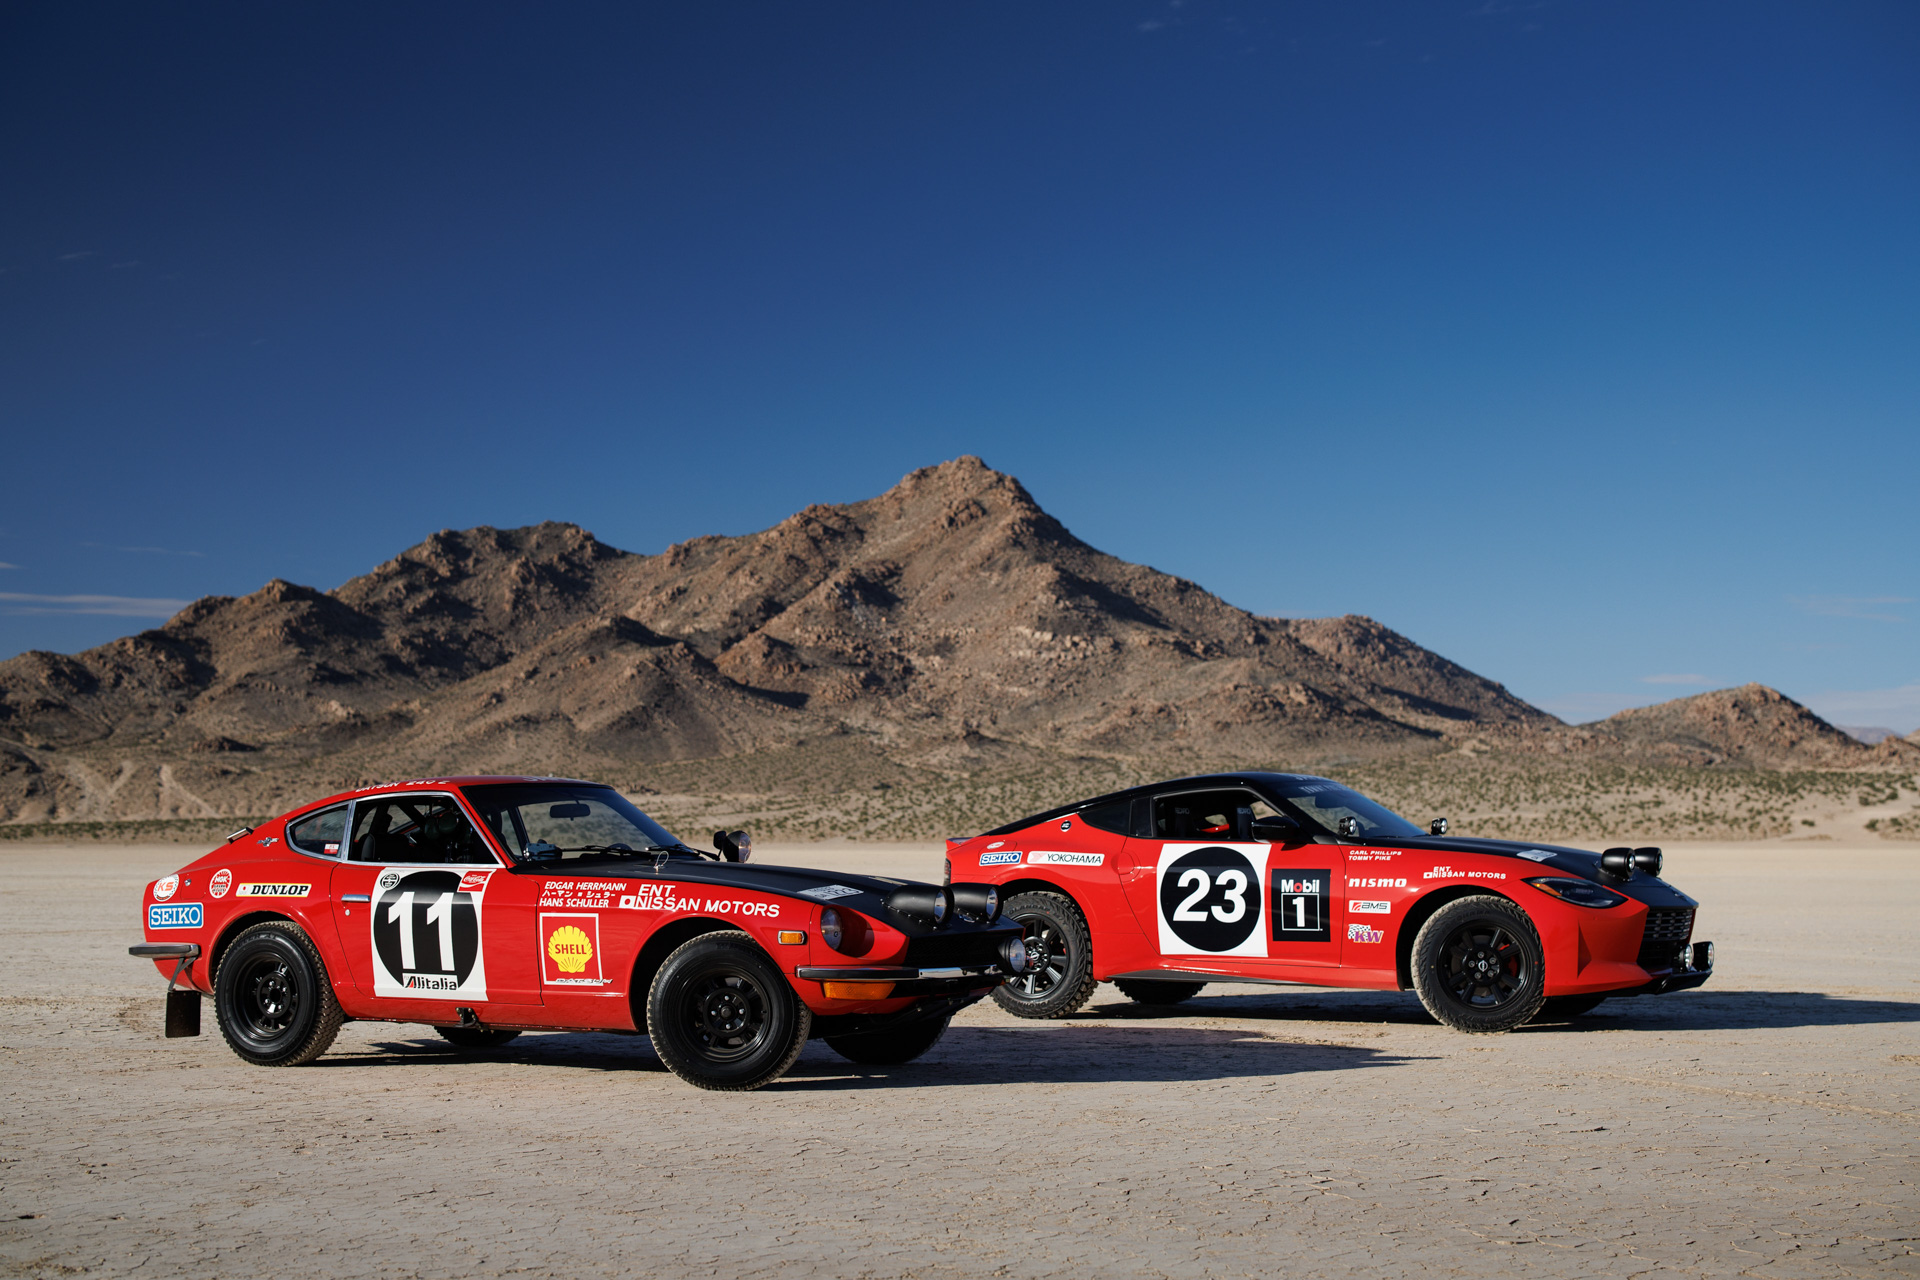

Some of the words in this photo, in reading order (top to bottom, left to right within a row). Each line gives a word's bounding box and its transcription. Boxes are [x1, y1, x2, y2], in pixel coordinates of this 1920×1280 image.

[981, 853, 1020, 864] SEIKO
[1047, 853, 1102, 864] YOKOHAMA
[1468, 872, 1506, 880] MOTORS
[157, 881, 174, 892] KS
[251, 885, 308, 895] DUNLOP
[544, 881, 574, 890] EDGAR
[576, 882, 627, 891] HERRMANN
[638, 883, 676, 898] ENT.
[1281, 879, 1320, 893] Mobil
[1172, 868, 1248, 923] 23
[539, 898, 563, 907] HANS
[566, 898, 609, 908] SCHULLER
[635, 896, 700, 911] NISSAN
[704, 899, 780, 918] MOTORS
[151, 906, 201, 926] SEIKO
[1292, 896, 1305, 928] 1
[388, 891, 455, 971] 11
[1354, 930, 1384, 944] KW
[555, 943, 587, 955] SHELL
[405, 975, 457, 991] Alitalia
